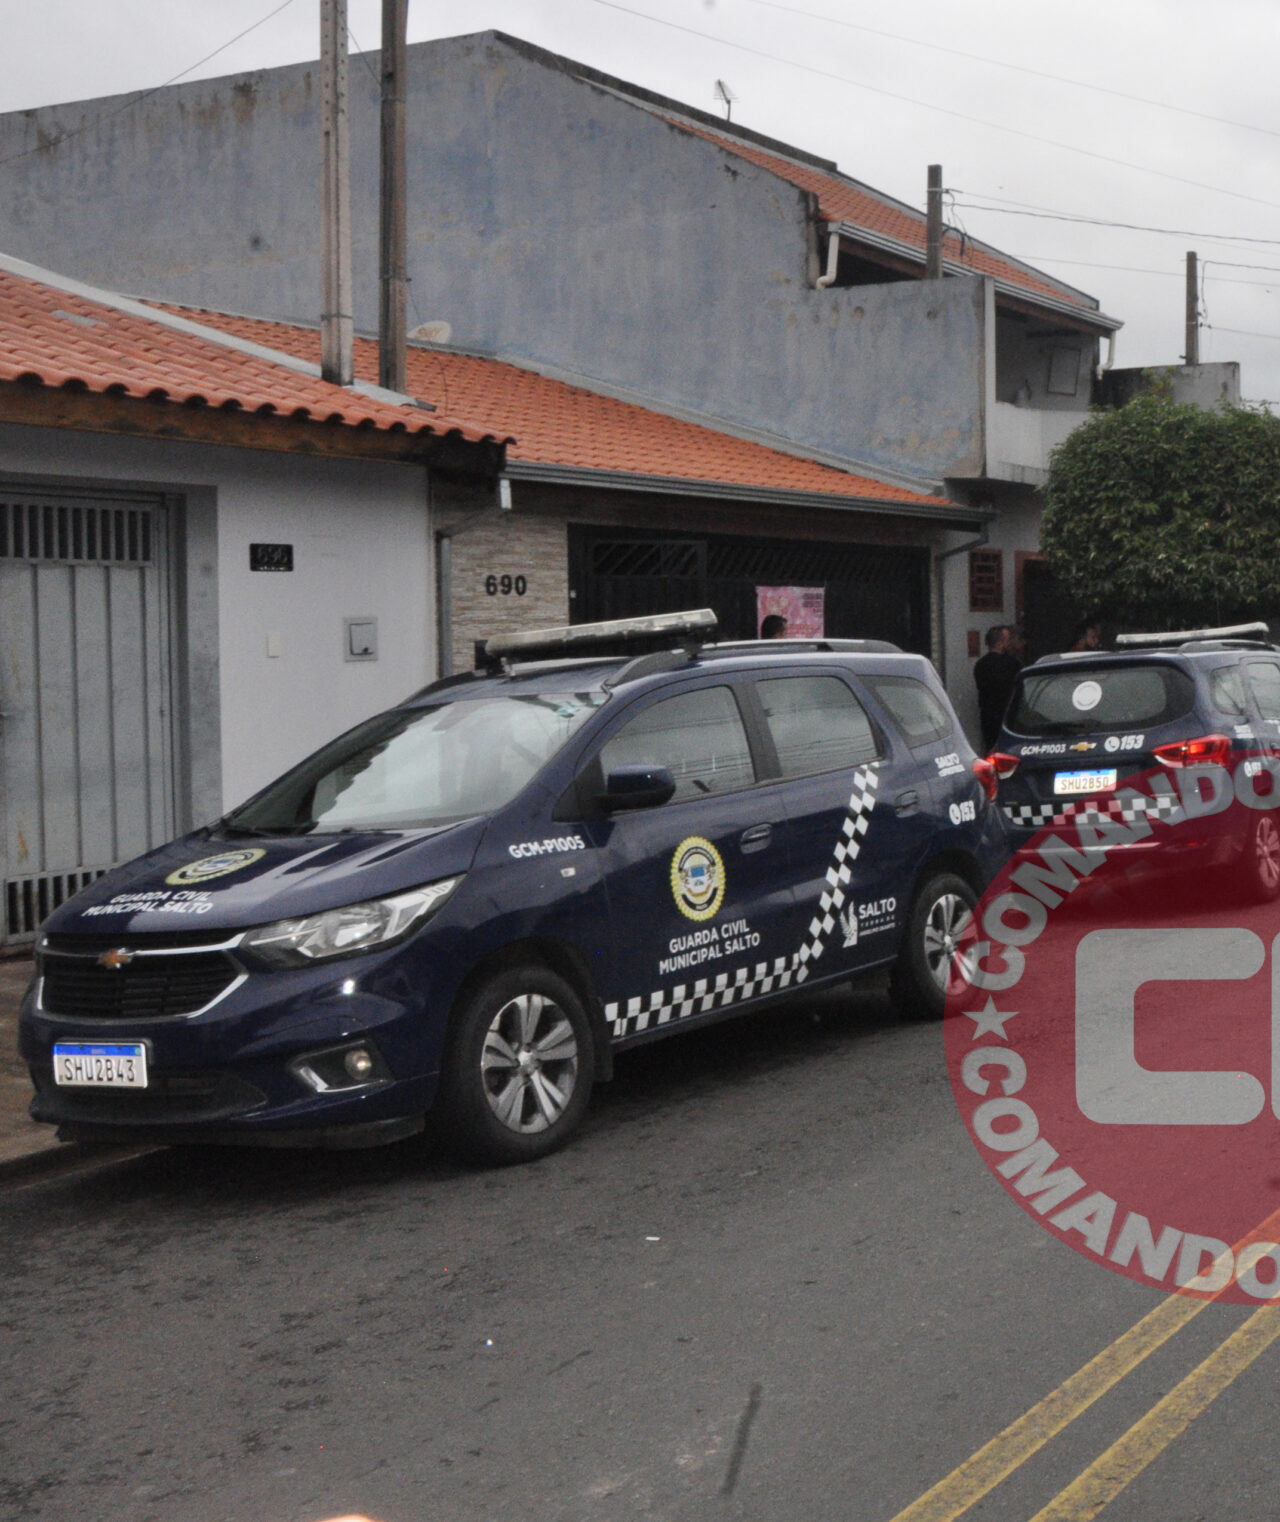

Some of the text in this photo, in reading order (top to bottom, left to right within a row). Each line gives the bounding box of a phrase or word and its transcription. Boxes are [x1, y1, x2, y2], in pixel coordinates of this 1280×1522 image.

[485, 574, 527, 596] 690
[1020, 743, 1067, 756] GCM-P1003
[1120, 735, 1145, 750] 153
[1061, 776, 1110, 791] SHU2B50
[960, 800, 976, 822] 153
[508, 835, 585, 859] GCM-P1005
[110, 891, 212, 904] GUARDA CIVIL
[859, 897, 896, 919] SALTO
[81, 901, 214, 917] MUNICIPAL SALTO
[669, 919, 750, 953] GUARDA CIVIL
[659, 932, 760, 975] MUNICIPAL SALTO
[64, 1058, 135, 1082] SHU2B43
